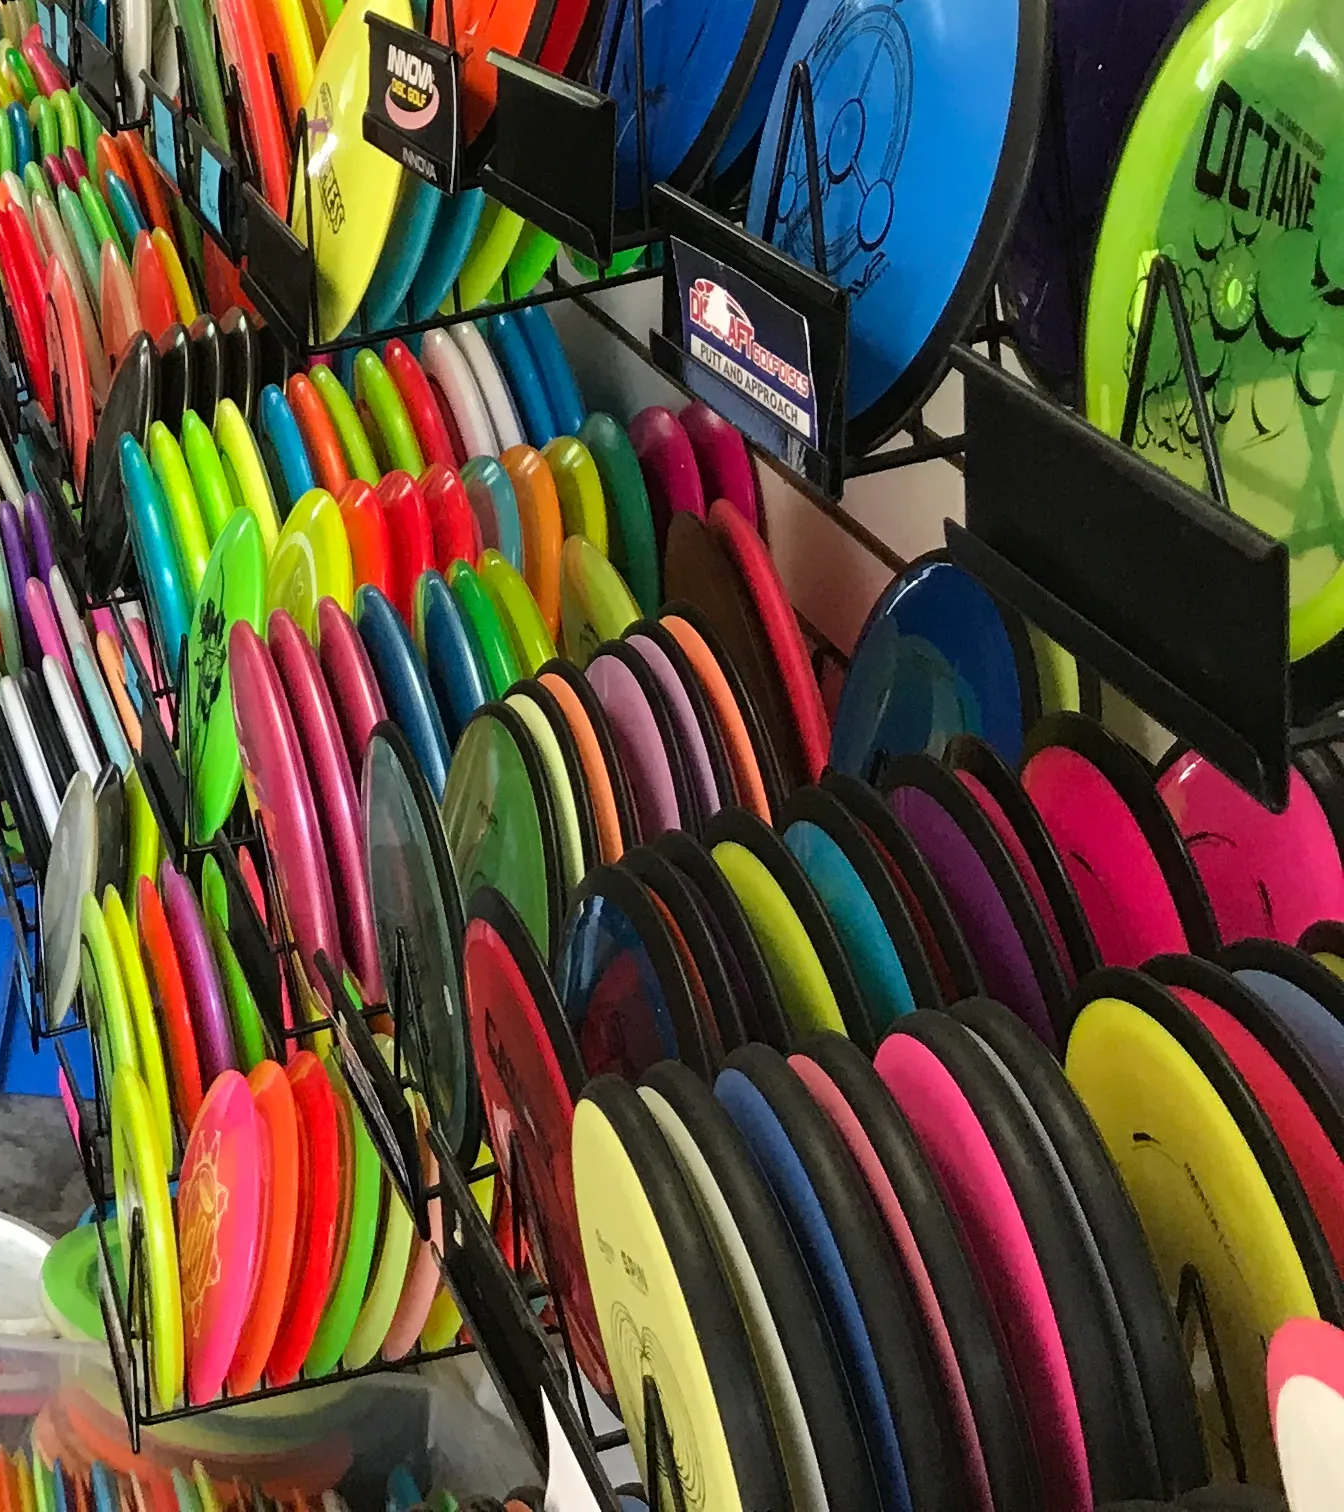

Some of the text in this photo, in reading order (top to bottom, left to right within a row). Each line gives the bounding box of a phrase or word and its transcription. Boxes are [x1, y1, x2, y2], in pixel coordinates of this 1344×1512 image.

[387, 44, 435, 94] INNOVA
[391, 78, 427, 108] DISC GOLF
[1195, 80, 1321, 232] OCTANE
[700, 345, 798, 426] PUTT AND APPROACH
